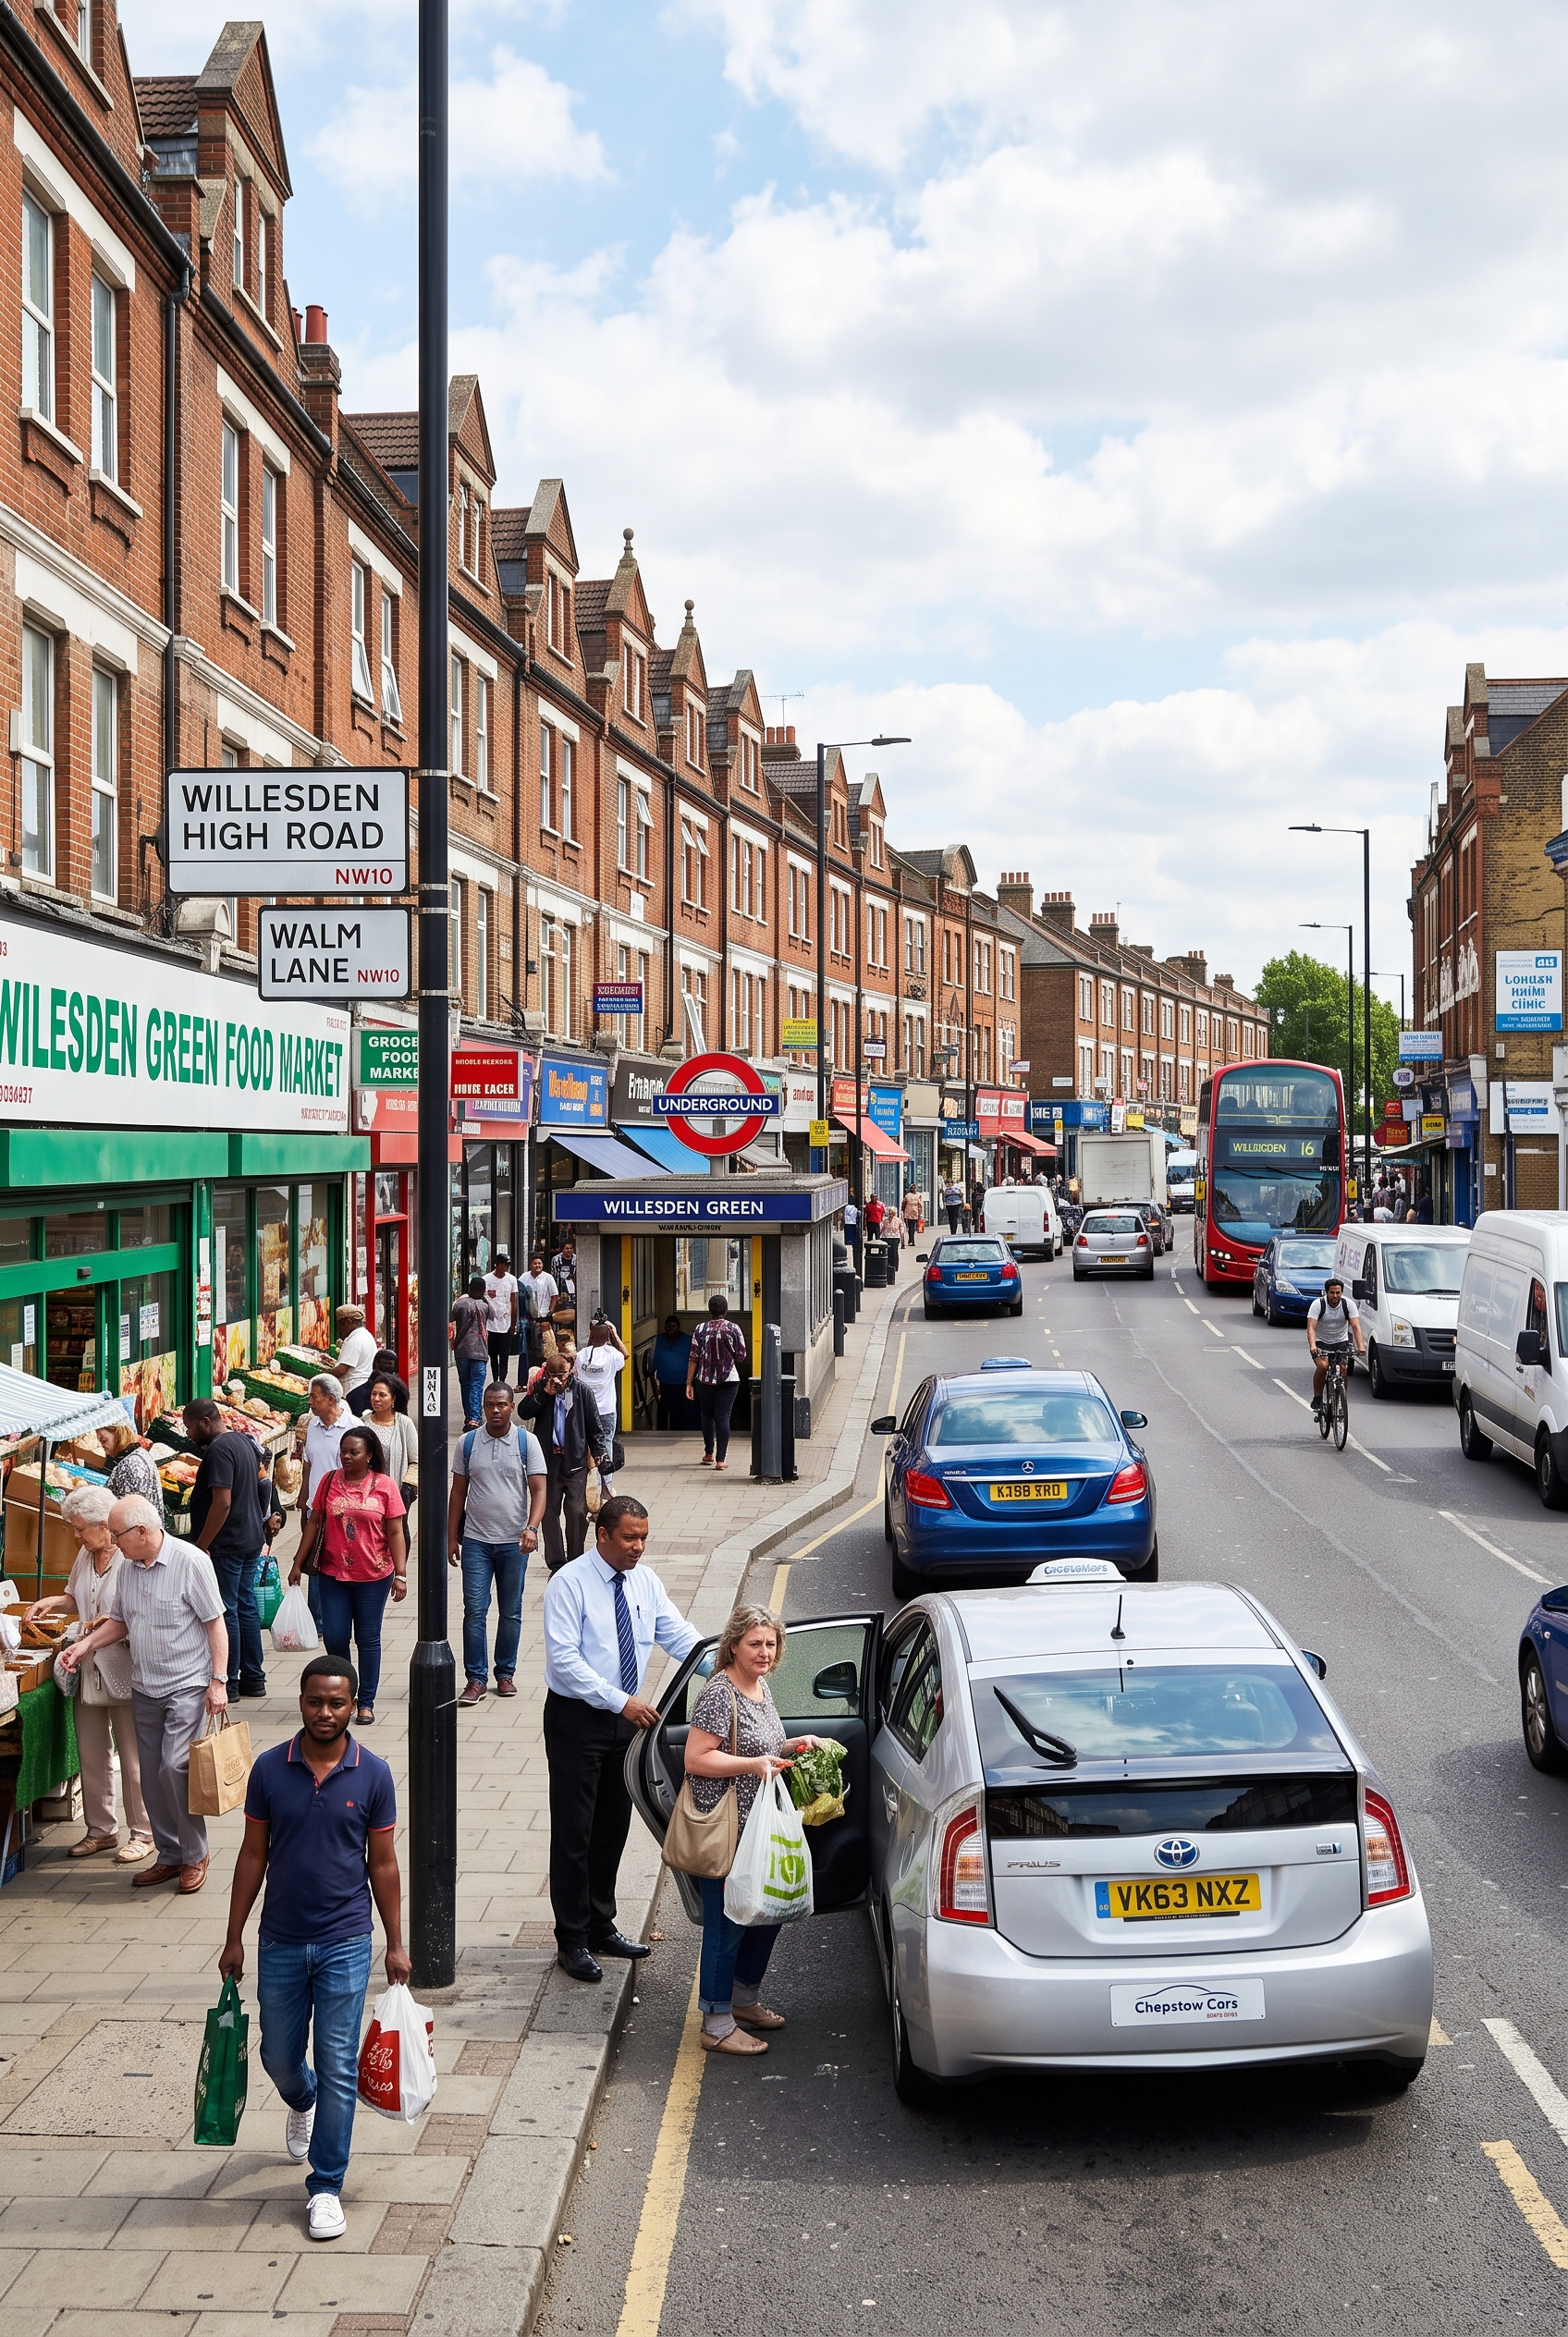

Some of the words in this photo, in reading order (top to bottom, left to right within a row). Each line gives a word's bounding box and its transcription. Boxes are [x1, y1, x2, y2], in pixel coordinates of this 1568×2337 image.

[181, 784, 380, 813] WILLESDEN
[183, 822, 268, 850] HIGH
[287, 821, 385, 850] ROAD
[335, 867, 393, 885] NW10
[269, 923, 361, 949] WALM
[271, 958, 349, 984] LANE
[357, 969, 400, 983] NW10
[0, 978, 138, 1079] WILESDEN
[145, 1007, 219, 1087] GREEN
[225, 1022, 275, 1092] FOOD
[279, 1032, 343, 1098] MARKET
[657, 1097, 774, 1112] UNDERGROUND
[1301, 1141, 1315, 1156] 16
[603, 1200, 700, 1216] WILLESDEN
[705, 1200, 765, 1216] GREEN
[1117, 1882, 1189, 1913] VK63
[1196, 1878, 1251, 1909] NXZ
[1134, 2000, 1204, 2015] Chepstow
[1207, 1998, 1238, 2010] Cars
